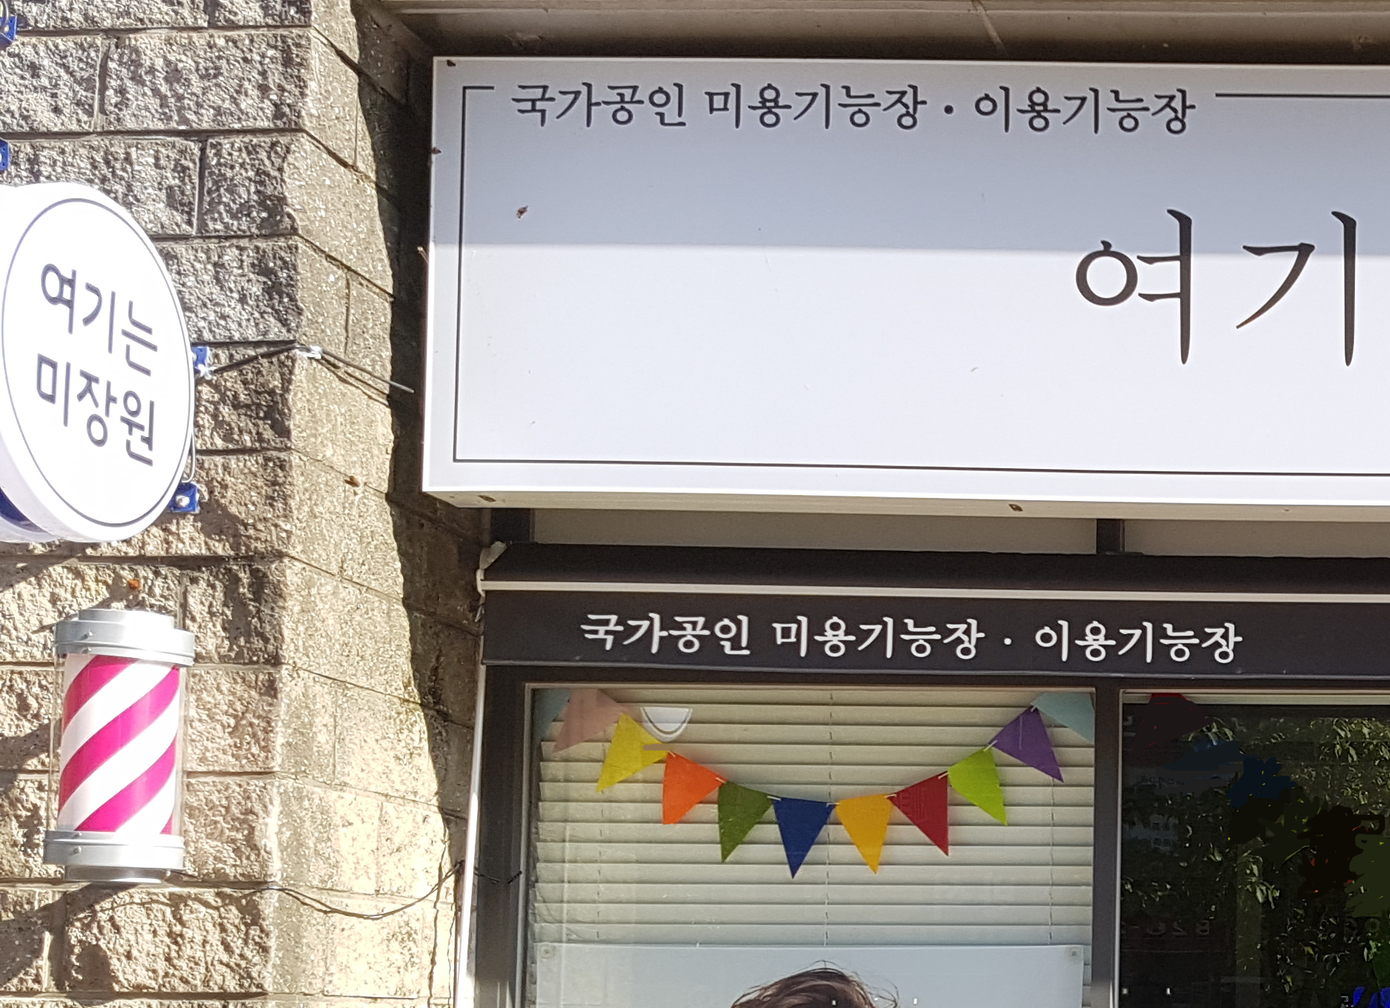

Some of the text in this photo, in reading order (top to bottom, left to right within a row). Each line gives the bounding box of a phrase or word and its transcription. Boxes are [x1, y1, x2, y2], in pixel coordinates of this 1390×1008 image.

[512, 82, 686, 128] 국가공인
[705, 83, 927, 130] 미용기능장
[975, 86, 1196, 135] 이용기능장
[41, 263, 158, 377] 여기는
[36, 353, 155, 467] 미장원
[580, 612, 751, 655] 국가공인
[772, 616, 986, 660] 미용기능장
[1036, 620, 1243, 664] 이용기능장
